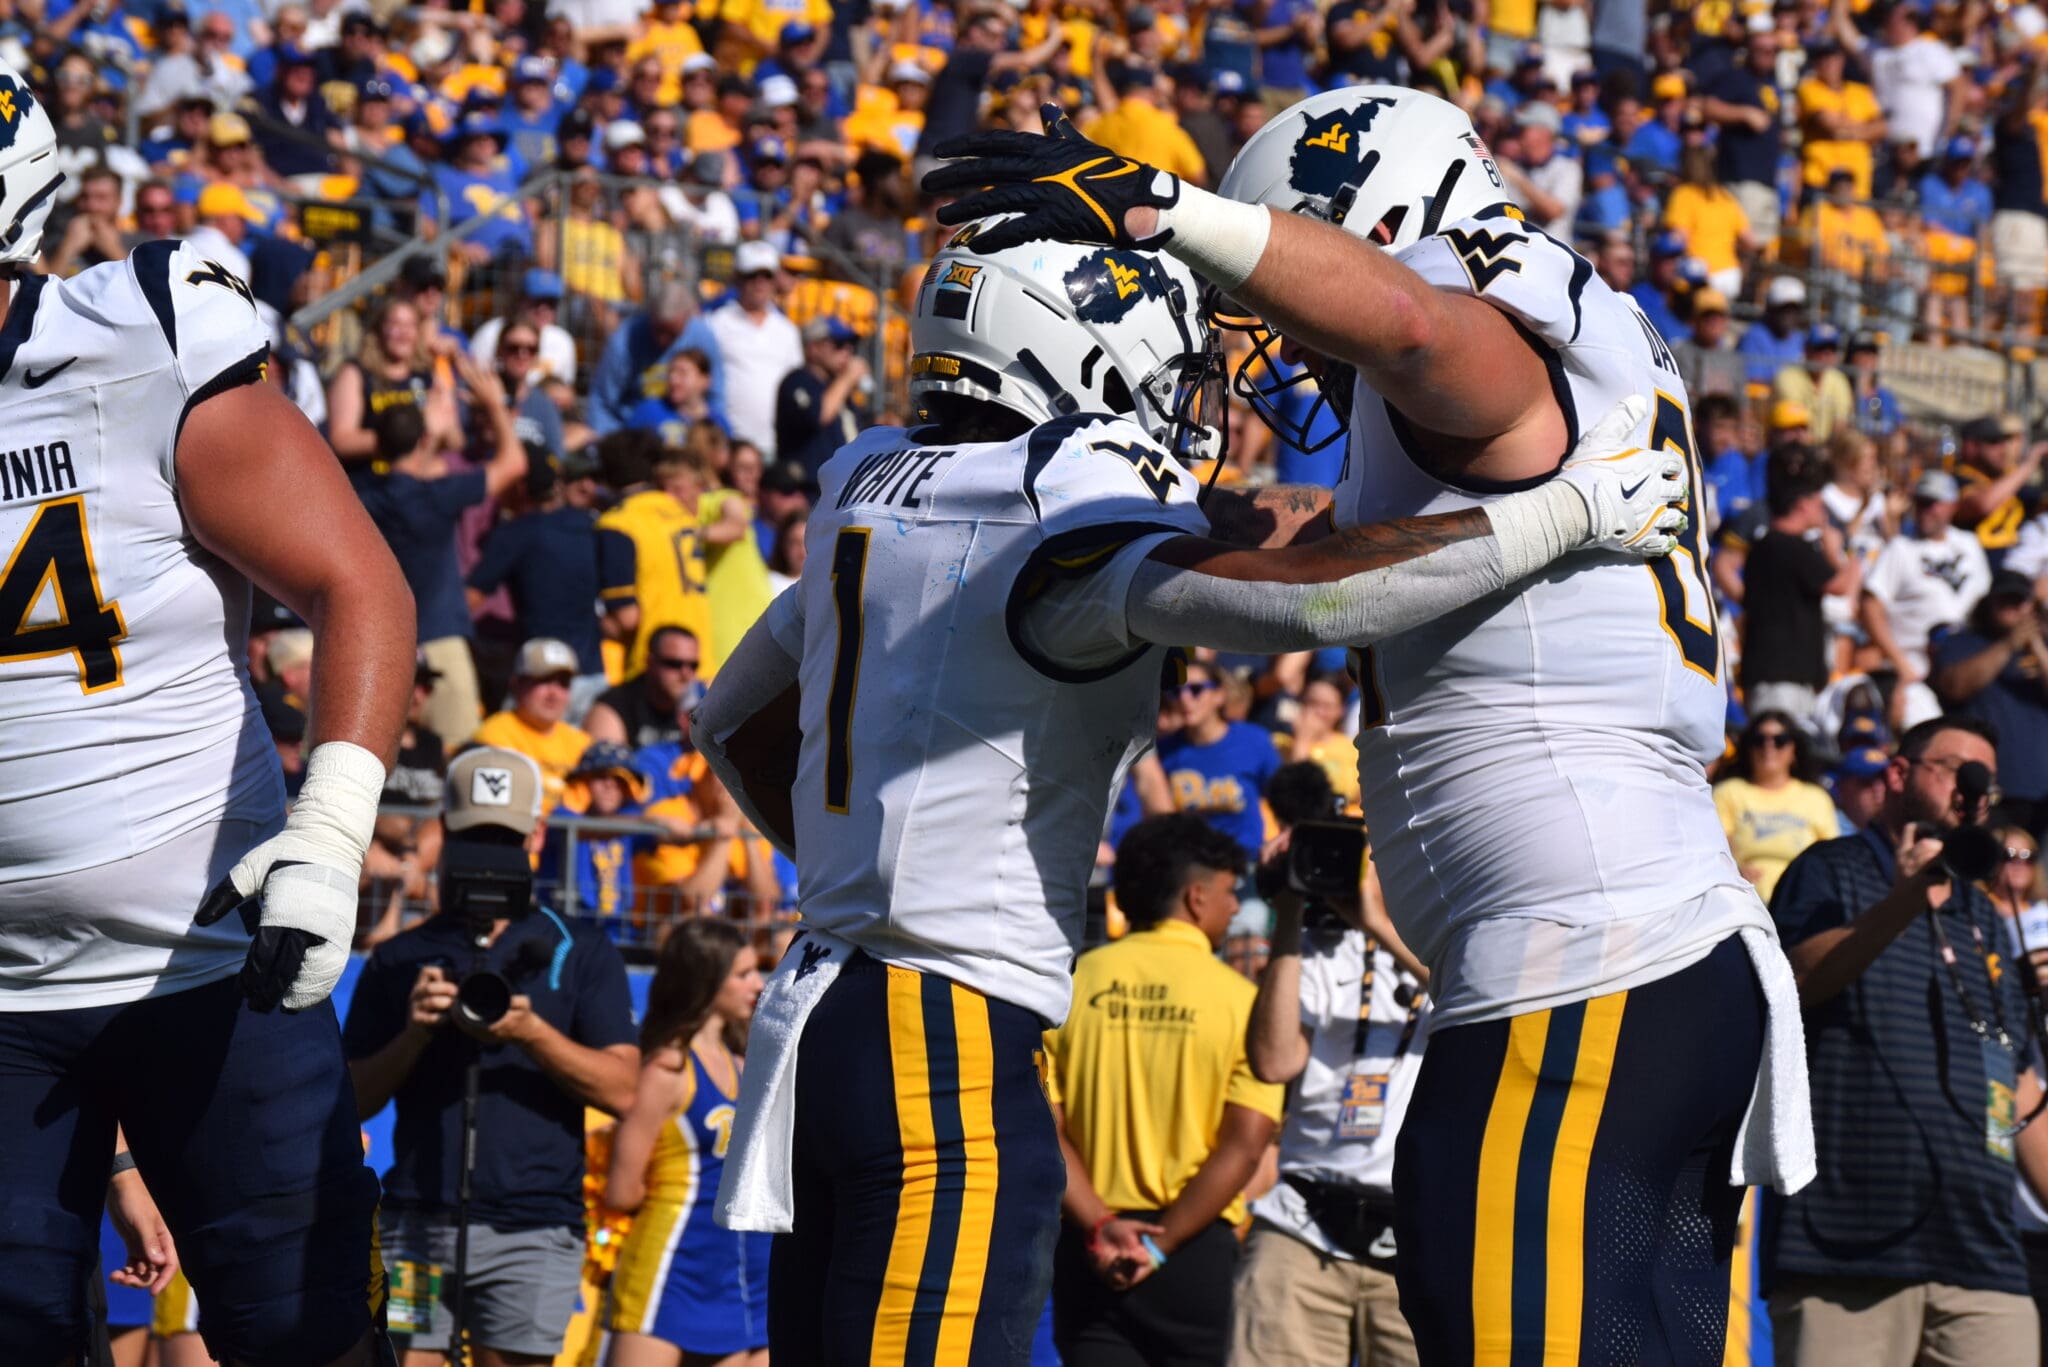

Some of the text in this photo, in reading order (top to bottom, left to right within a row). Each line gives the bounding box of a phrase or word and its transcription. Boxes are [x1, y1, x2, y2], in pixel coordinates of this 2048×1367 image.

[0, 440, 77, 501] INIA
[835, 450, 957, 508] WHITE
[0, 495, 129, 695] 4
[825, 526, 873, 816] 1
[1109, 980, 1168, 1000] ALLIED
